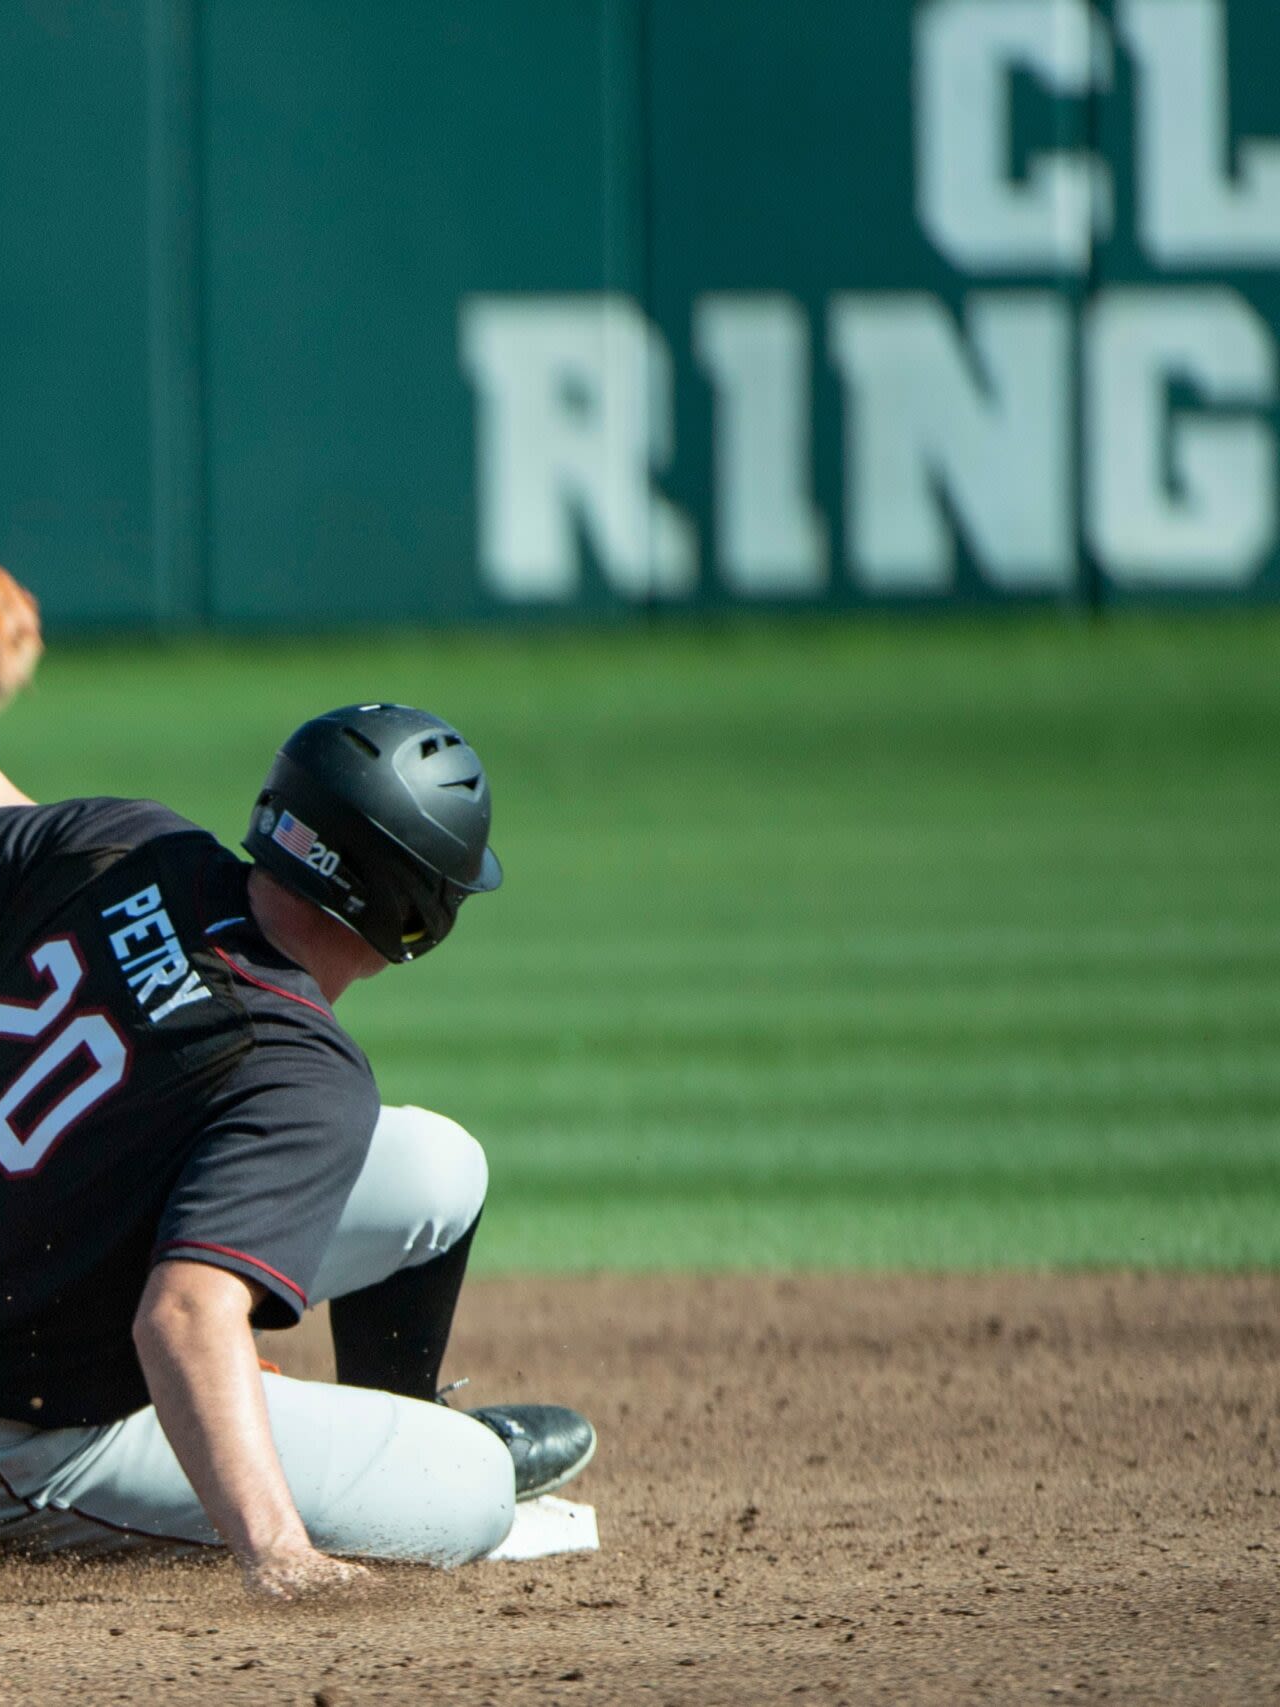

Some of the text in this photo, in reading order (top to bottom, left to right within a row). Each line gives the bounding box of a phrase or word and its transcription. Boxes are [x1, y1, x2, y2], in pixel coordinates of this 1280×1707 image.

[460, 288, 1278, 598] RING
[306, 842, 340, 877] 20
[101, 883, 213, 1024] PETRY
